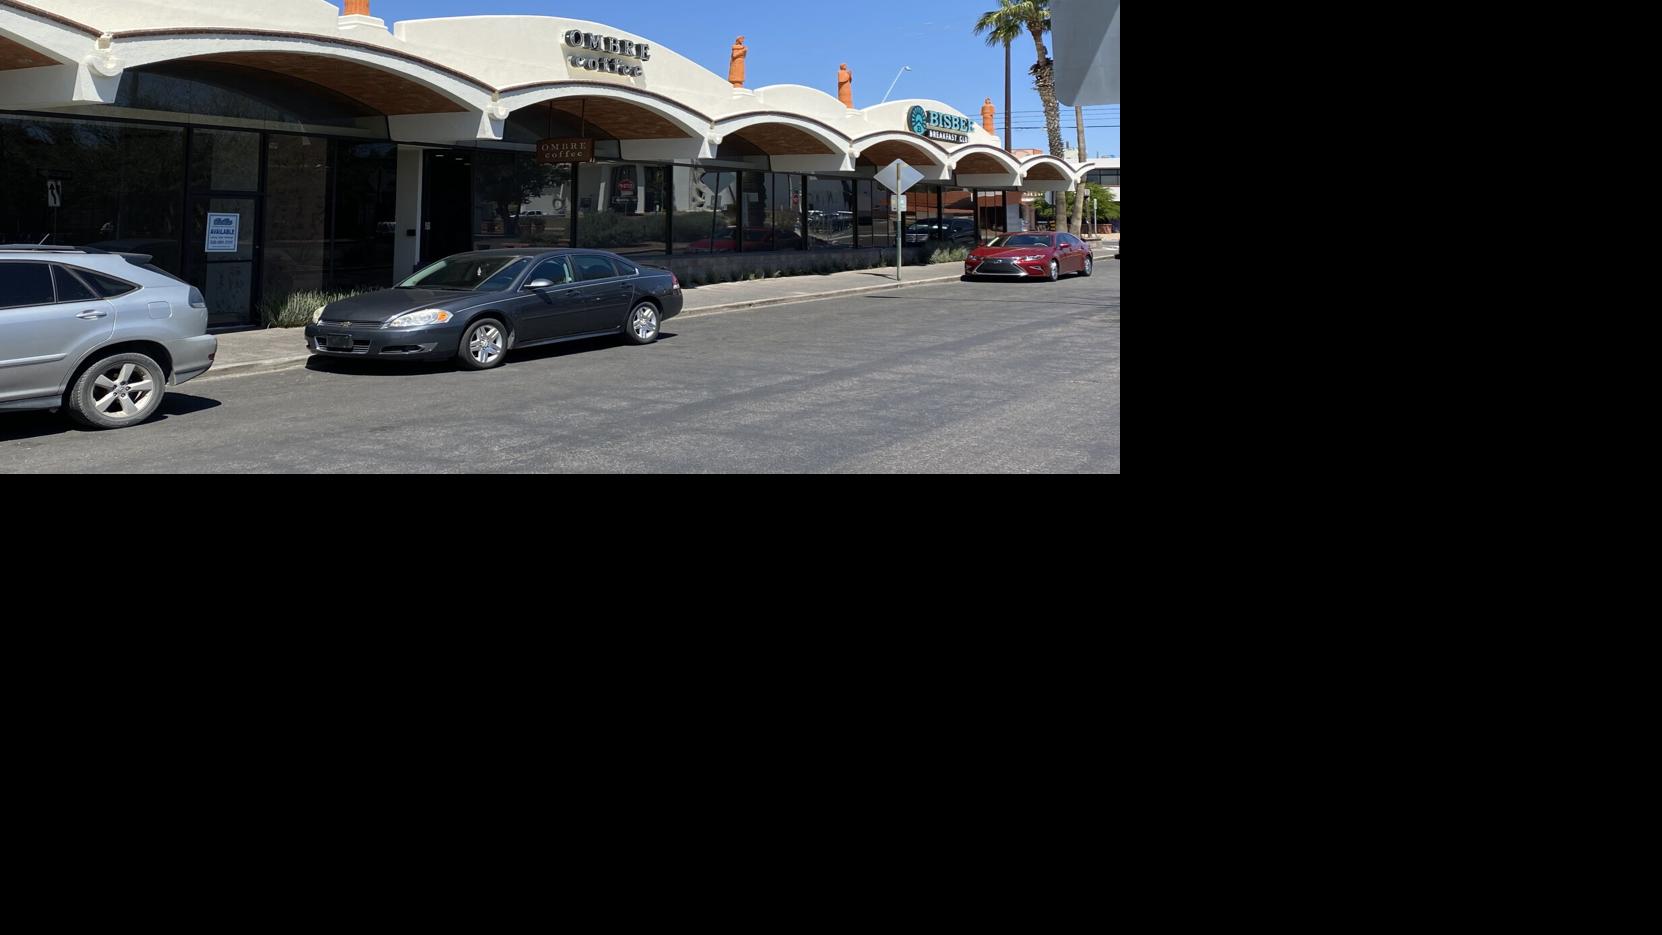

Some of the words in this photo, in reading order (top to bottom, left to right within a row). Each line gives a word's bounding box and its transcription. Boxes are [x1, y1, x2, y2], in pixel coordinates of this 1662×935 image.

[565, 29, 651, 61] OMBRE
[570, 55, 643, 77] coffee
[927, 110, 976, 133] BISBEE
[929, 130, 957, 142] BREAKFAST
[541, 142, 587, 151] OMBRE
[544, 150, 583, 159] coffee
